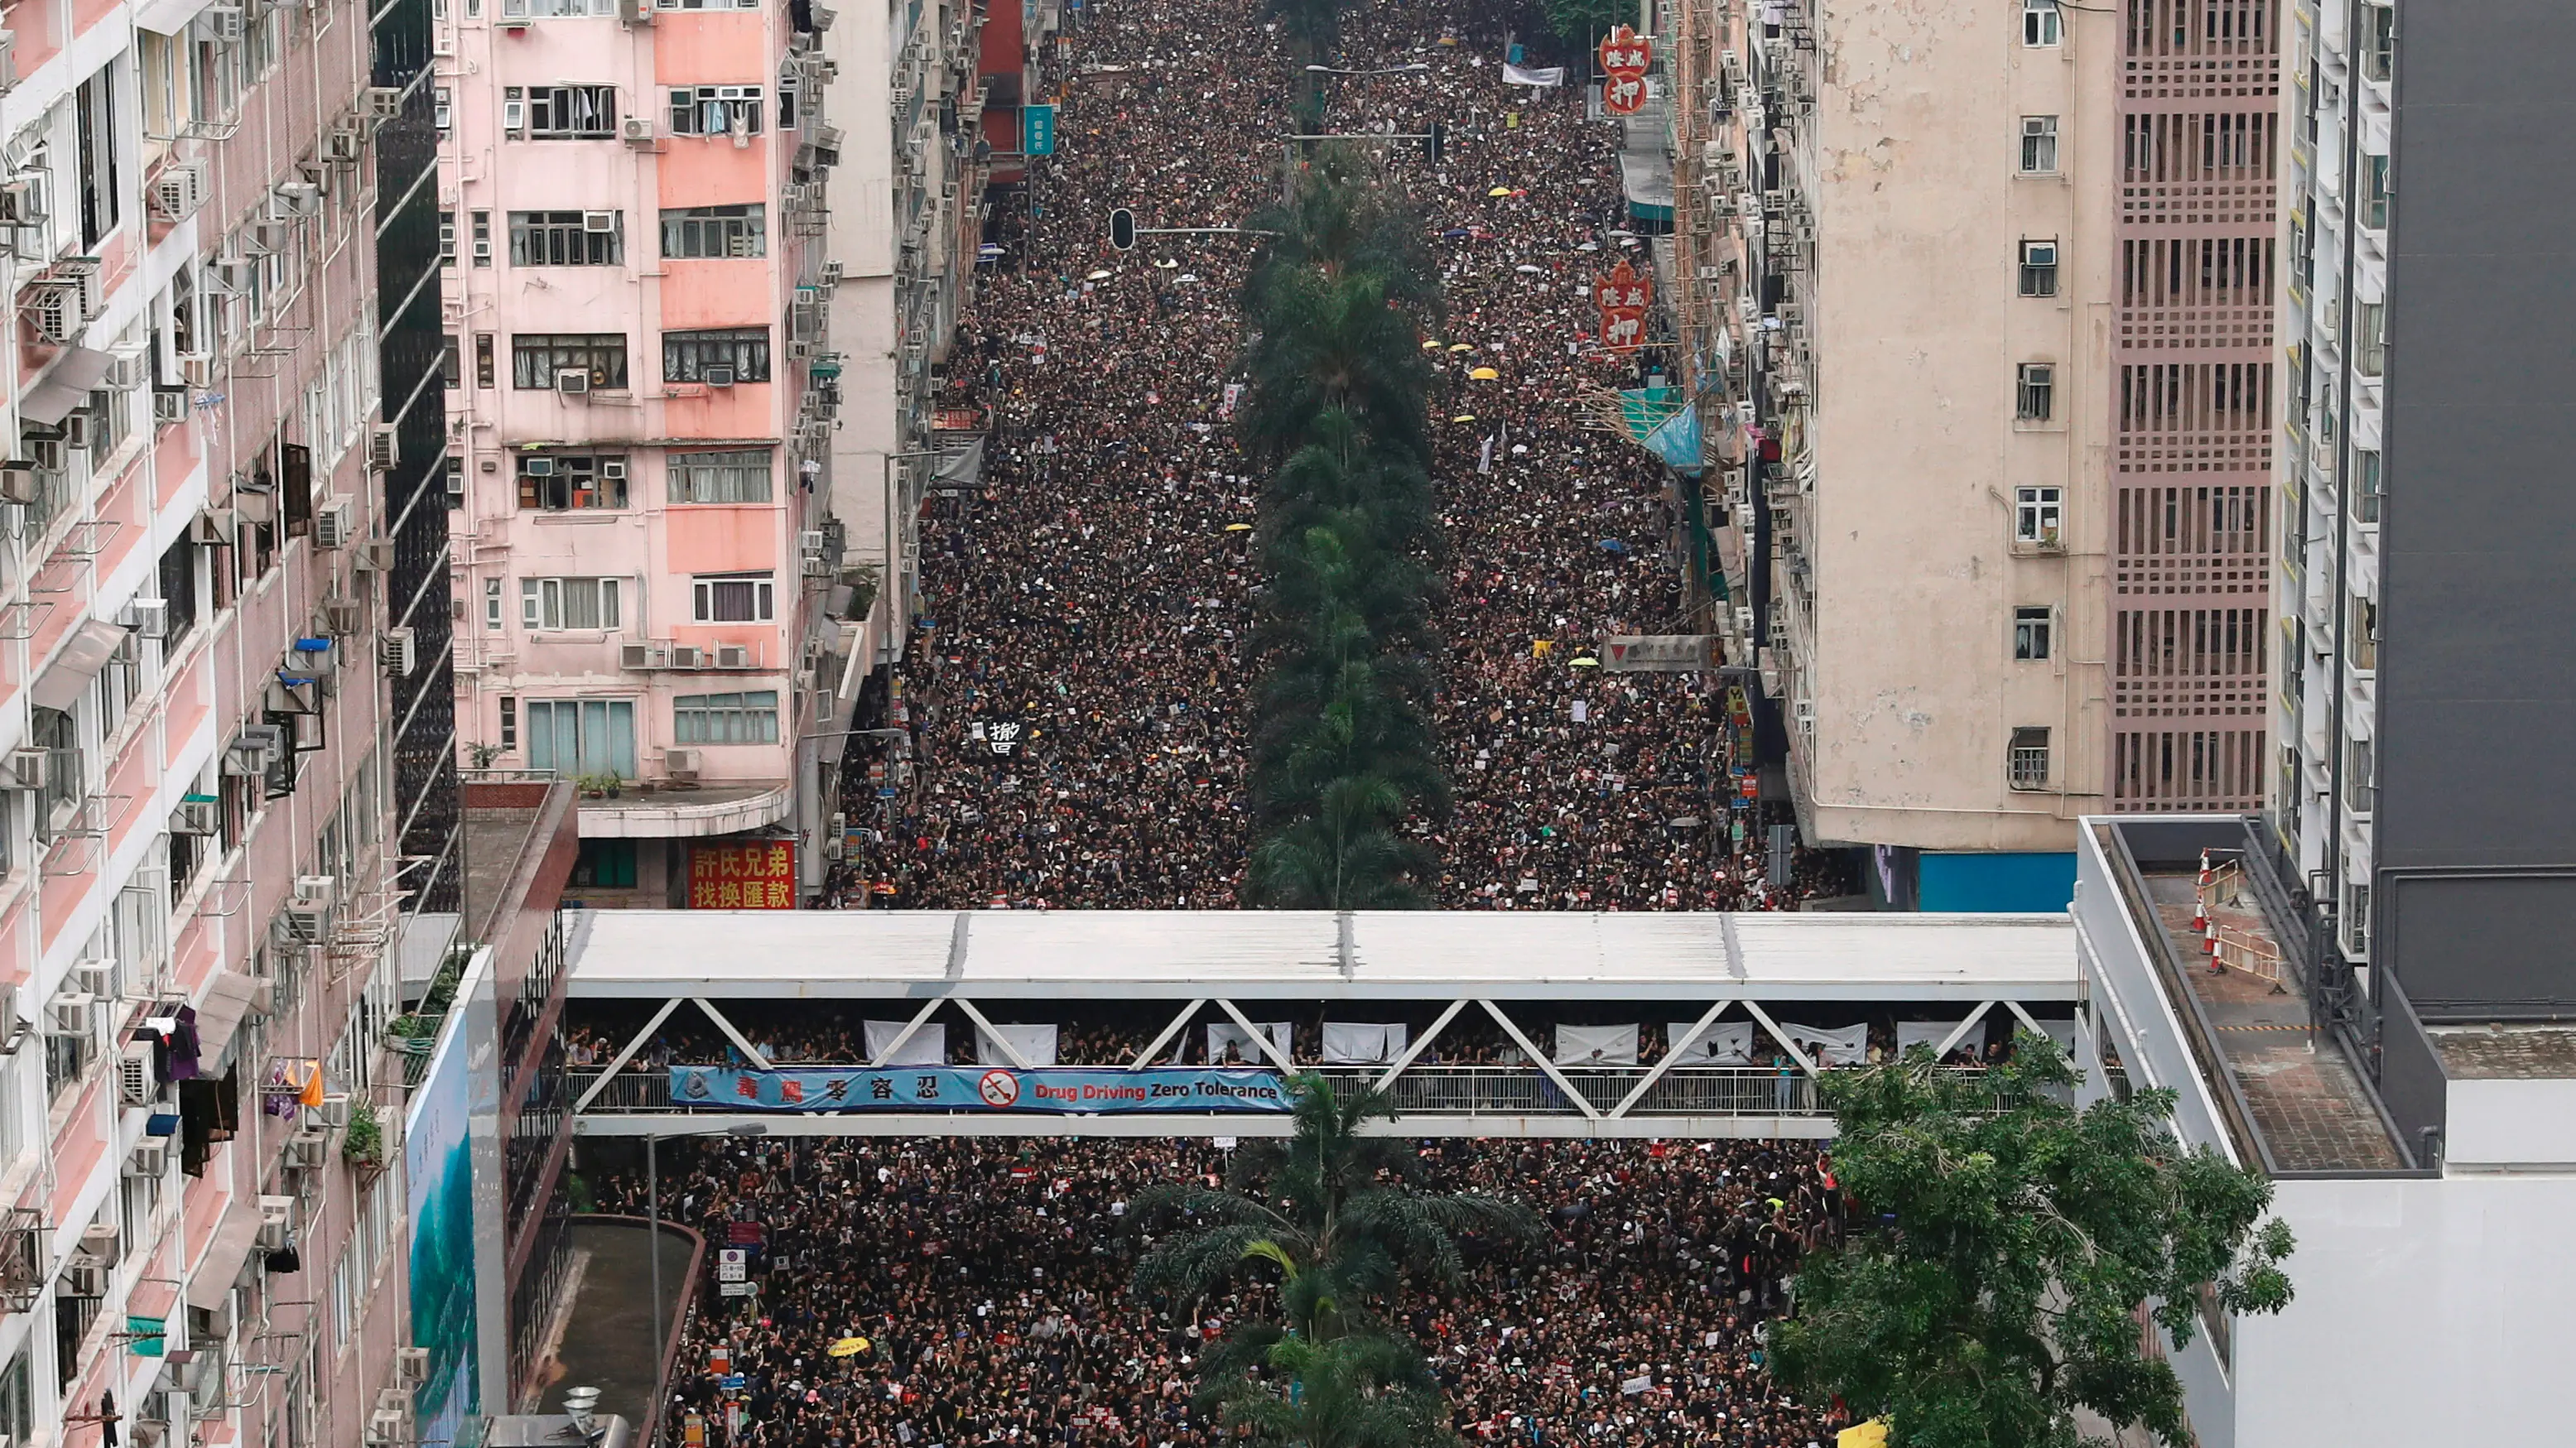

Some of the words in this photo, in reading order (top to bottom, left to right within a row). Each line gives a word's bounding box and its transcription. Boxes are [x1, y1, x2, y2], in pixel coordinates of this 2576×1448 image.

[1610, 76, 1639, 109] 押
[1606, 314, 1639, 346] 押
[989, 721, 1021, 757] 撤回
[694, 846, 789, 878] 許氏兄弟
[694, 880, 789, 908] 找換匯款
[736, 1075, 940, 1104] 毒駕零容忍
[1035, 1084, 1076, 1102] Drug
[1083, 1084, 1145, 1101] Driving
[1150, 1083, 1189, 1097] Zero
[1195, 1080, 1277, 1099] Tolerance
